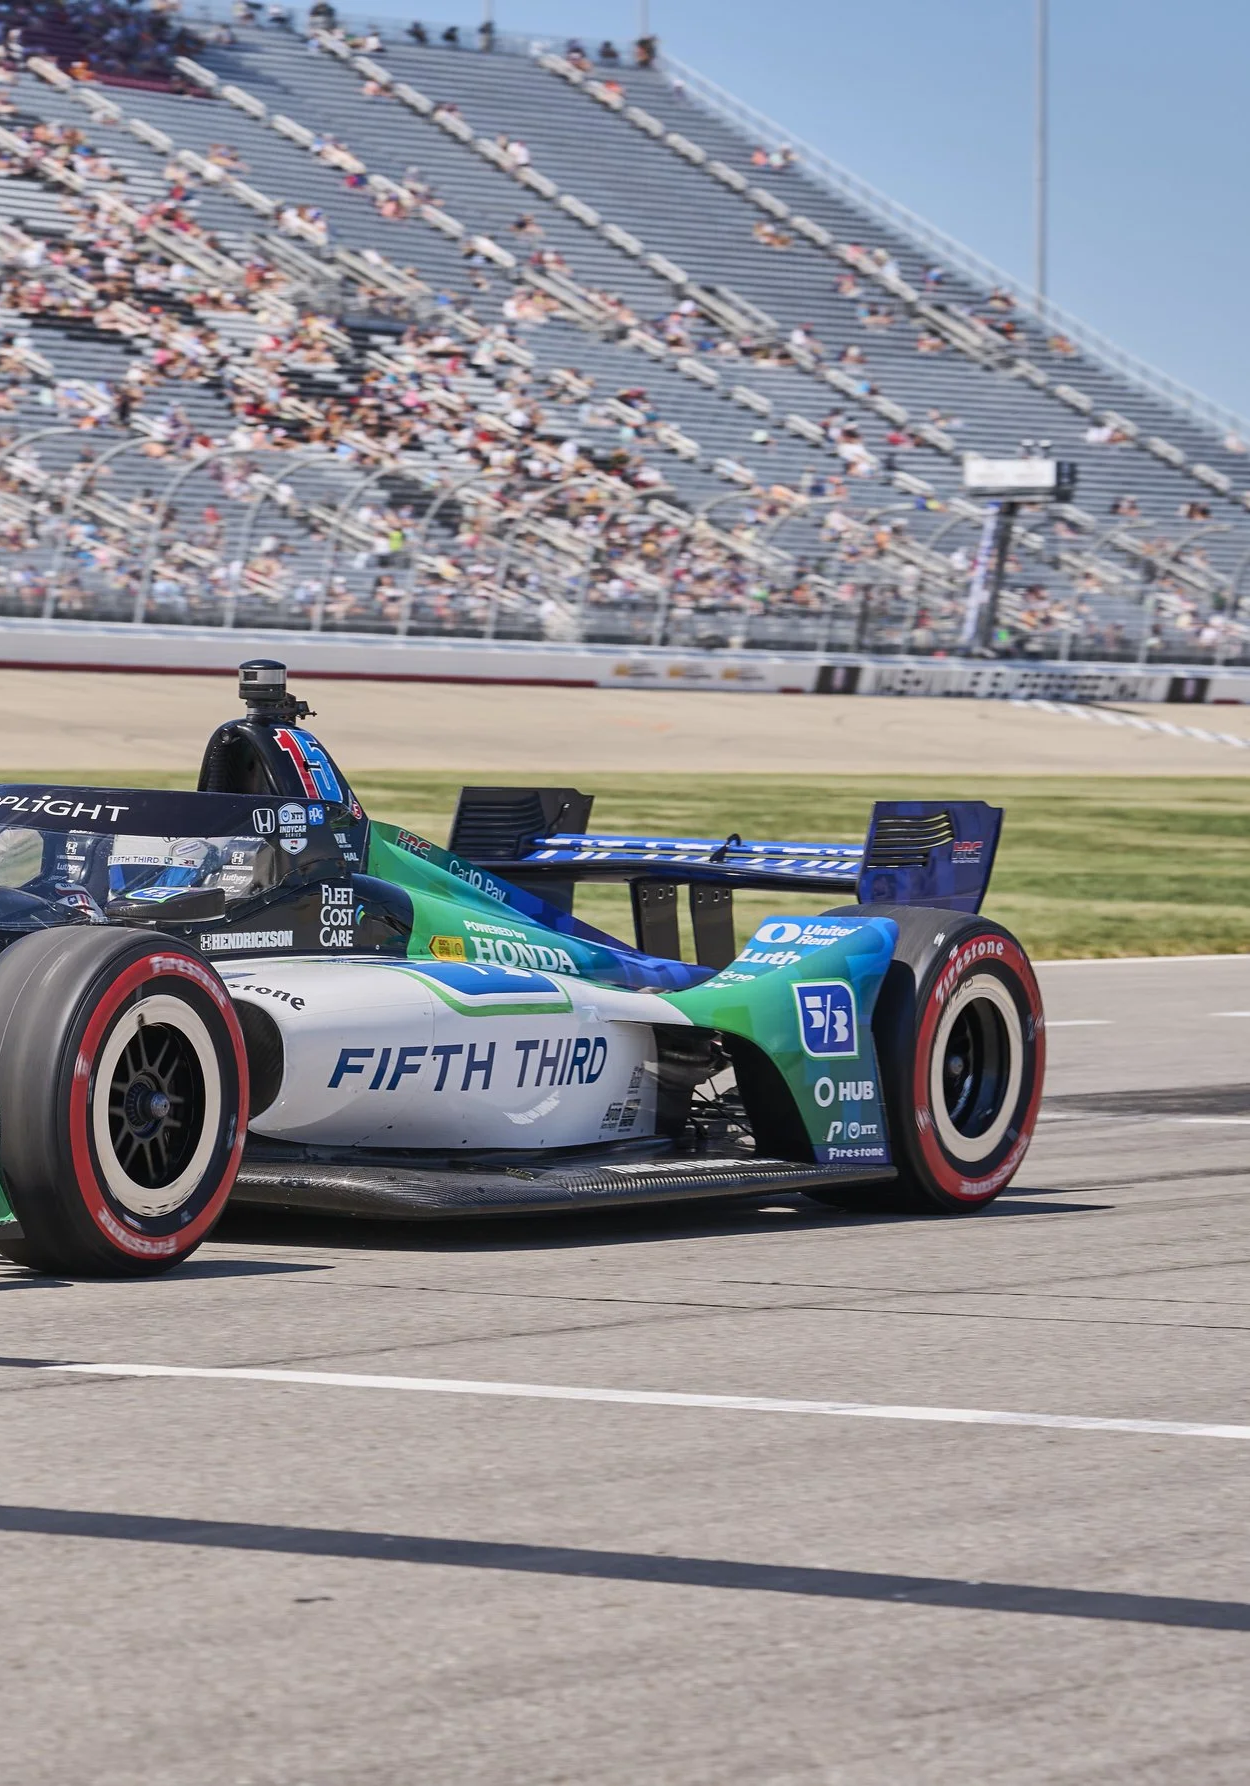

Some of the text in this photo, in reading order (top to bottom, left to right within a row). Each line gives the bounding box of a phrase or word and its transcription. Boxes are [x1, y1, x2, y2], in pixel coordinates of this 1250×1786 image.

[273, 729, 343, 803] 15
[308, 807, 324, 822] PPG
[280, 825, 306, 833] INDYCAR
[133, 856, 159, 864] THIRD
[321, 884, 353, 905] FLEET
[320, 905, 353, 926] COST
[319, 927, 353, 947] CARE
[463, 920, 513, 937] POWERED
[212, 930, 293, 950] HENDRICKSON
[795, 935, 838, 946] Rent
[470, 936, 579, 974] HONDA
[735, 949, 802, 965] Luth
[227, 982, 305, 1011] stone
[327, 1042, 496, 1091] FIFTH
[515, 1037, 607, 1087] THIRD
[839, 1081, 875, 1101] HUB
[828, 1147, 884, 1160] Firestone
